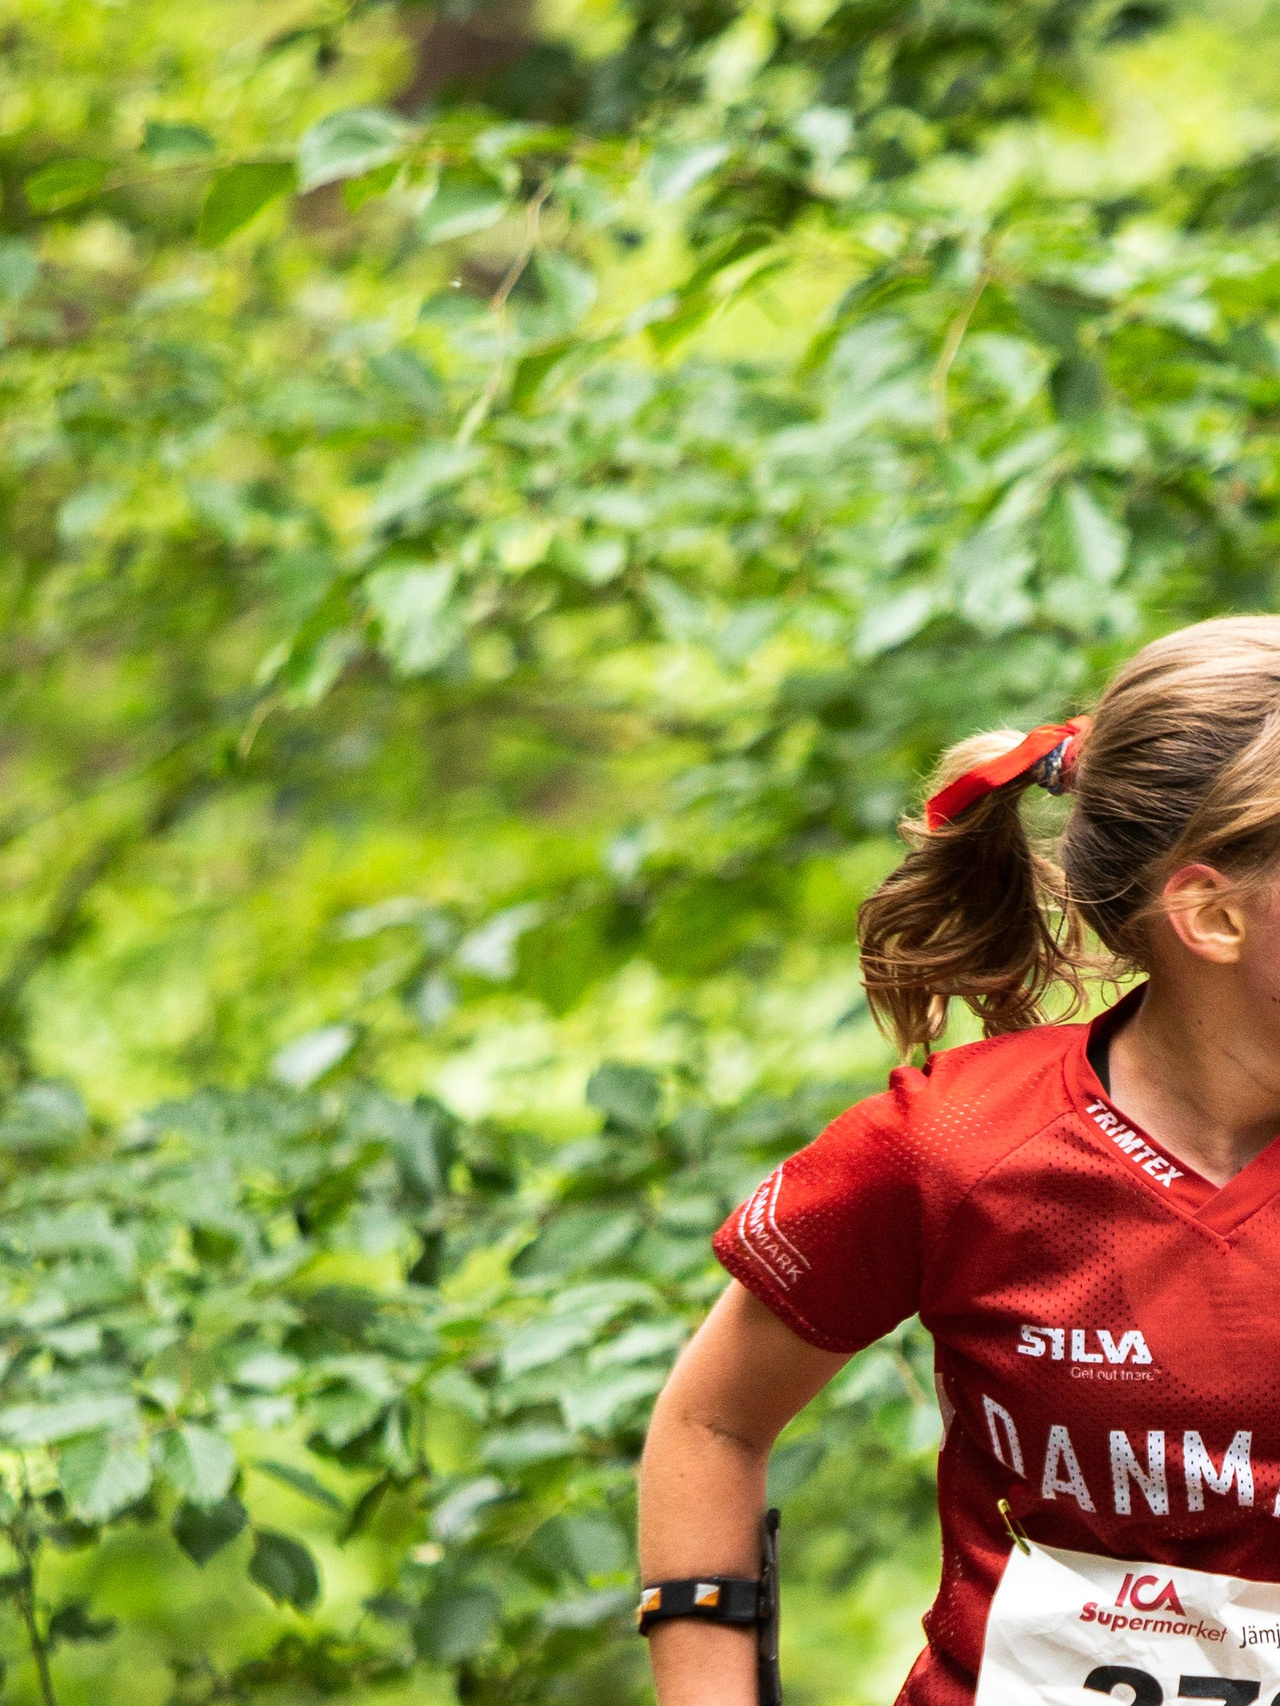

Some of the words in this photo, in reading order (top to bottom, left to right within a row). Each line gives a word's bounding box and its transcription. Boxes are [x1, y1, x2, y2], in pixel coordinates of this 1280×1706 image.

[1085, 1099, 1184, 1188] TRIMTEX
[1017, 1324, 1153, 1364] SILVA
[1070, 1366, 1094, 1380] Get
[1097, 1368, 1118, 1381] out
[1114, 1573, 1187, 1616] ICA
[1079, 1602, 1228, 1643] Supermarket
